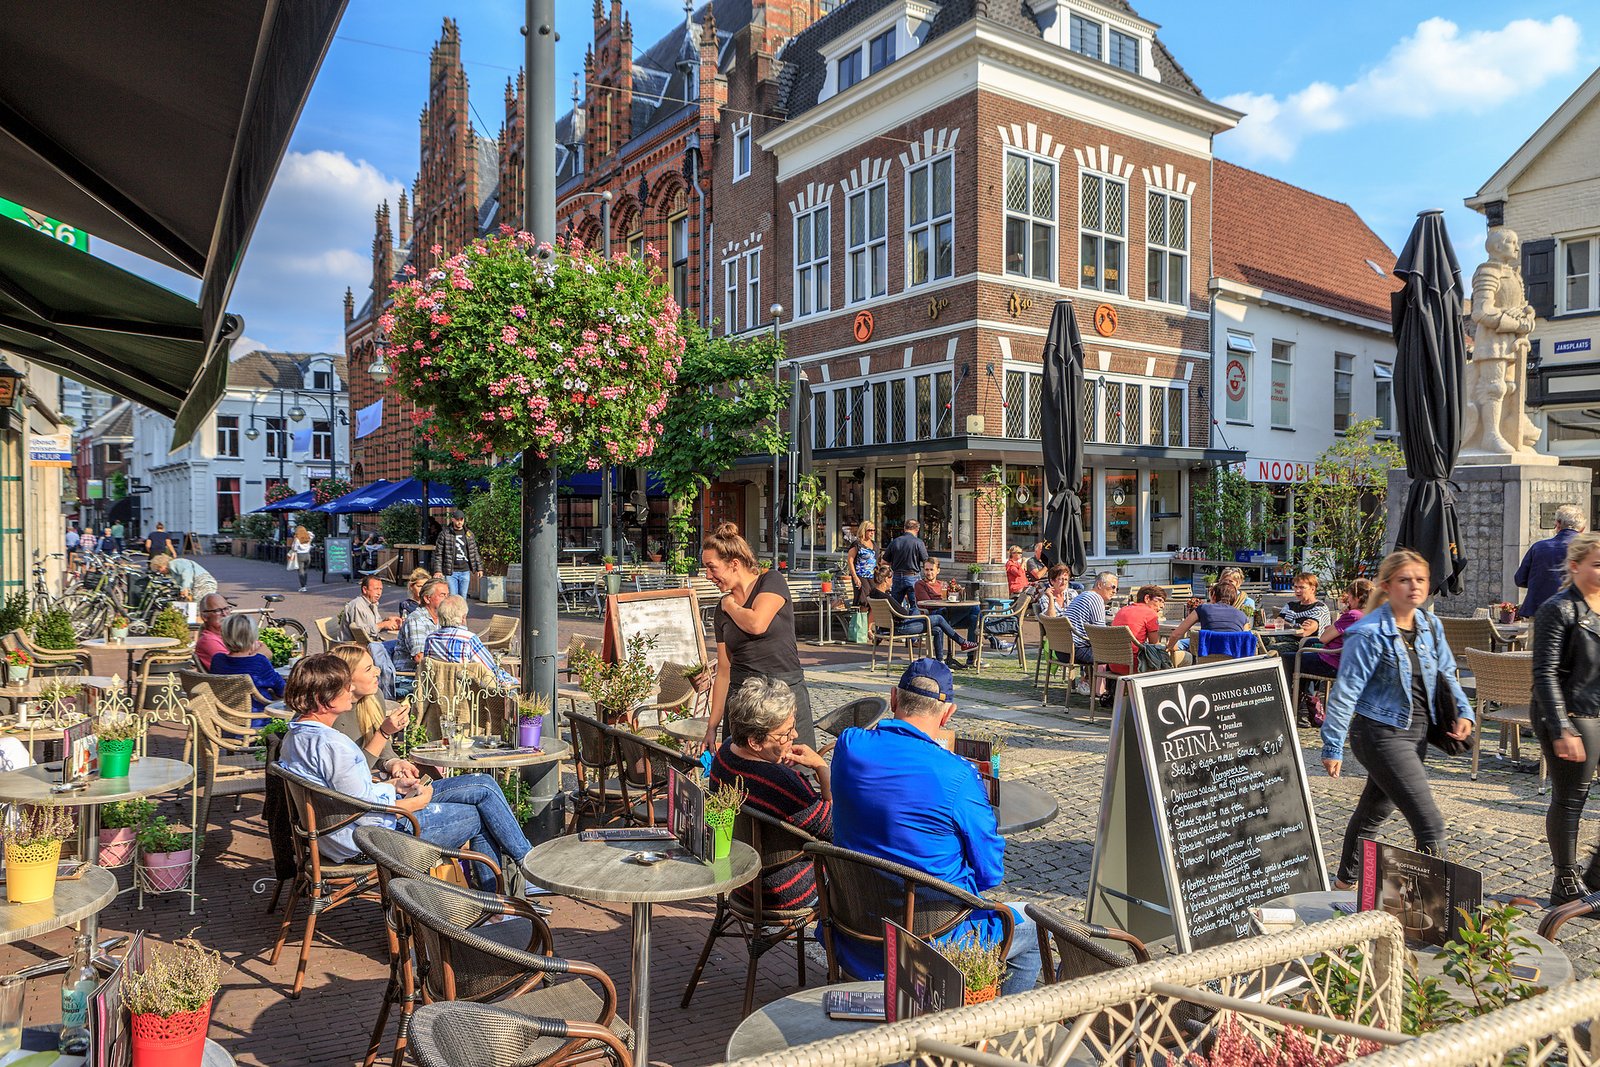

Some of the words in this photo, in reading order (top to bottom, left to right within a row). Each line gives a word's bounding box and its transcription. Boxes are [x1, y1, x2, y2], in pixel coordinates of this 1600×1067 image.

[1556, 342, 1588, 350] JANSPLAATS
[1212, 690, 1242, 702] DINING
[1242, 688, 1249, 696] &
[1250, 684, 1272, 694] MORE
[1214, 703, 1230, 712] Diverse
[1231, 700, 1248, 709] dranken
[1254, 696, 1275, 706] gerechten
[1220, 714, 1236, 722] Lunch
[1222, 721, 1243, 730] Dranken
[1224, 732, 1238, 740] Diner
[1161, 731, 1221, 762] REINA
[1226, 741, 1240, 749] Tapas
[1218, 752, 1234, 762] menu
[1364, 845, 1375, 911] UNCHKAART
